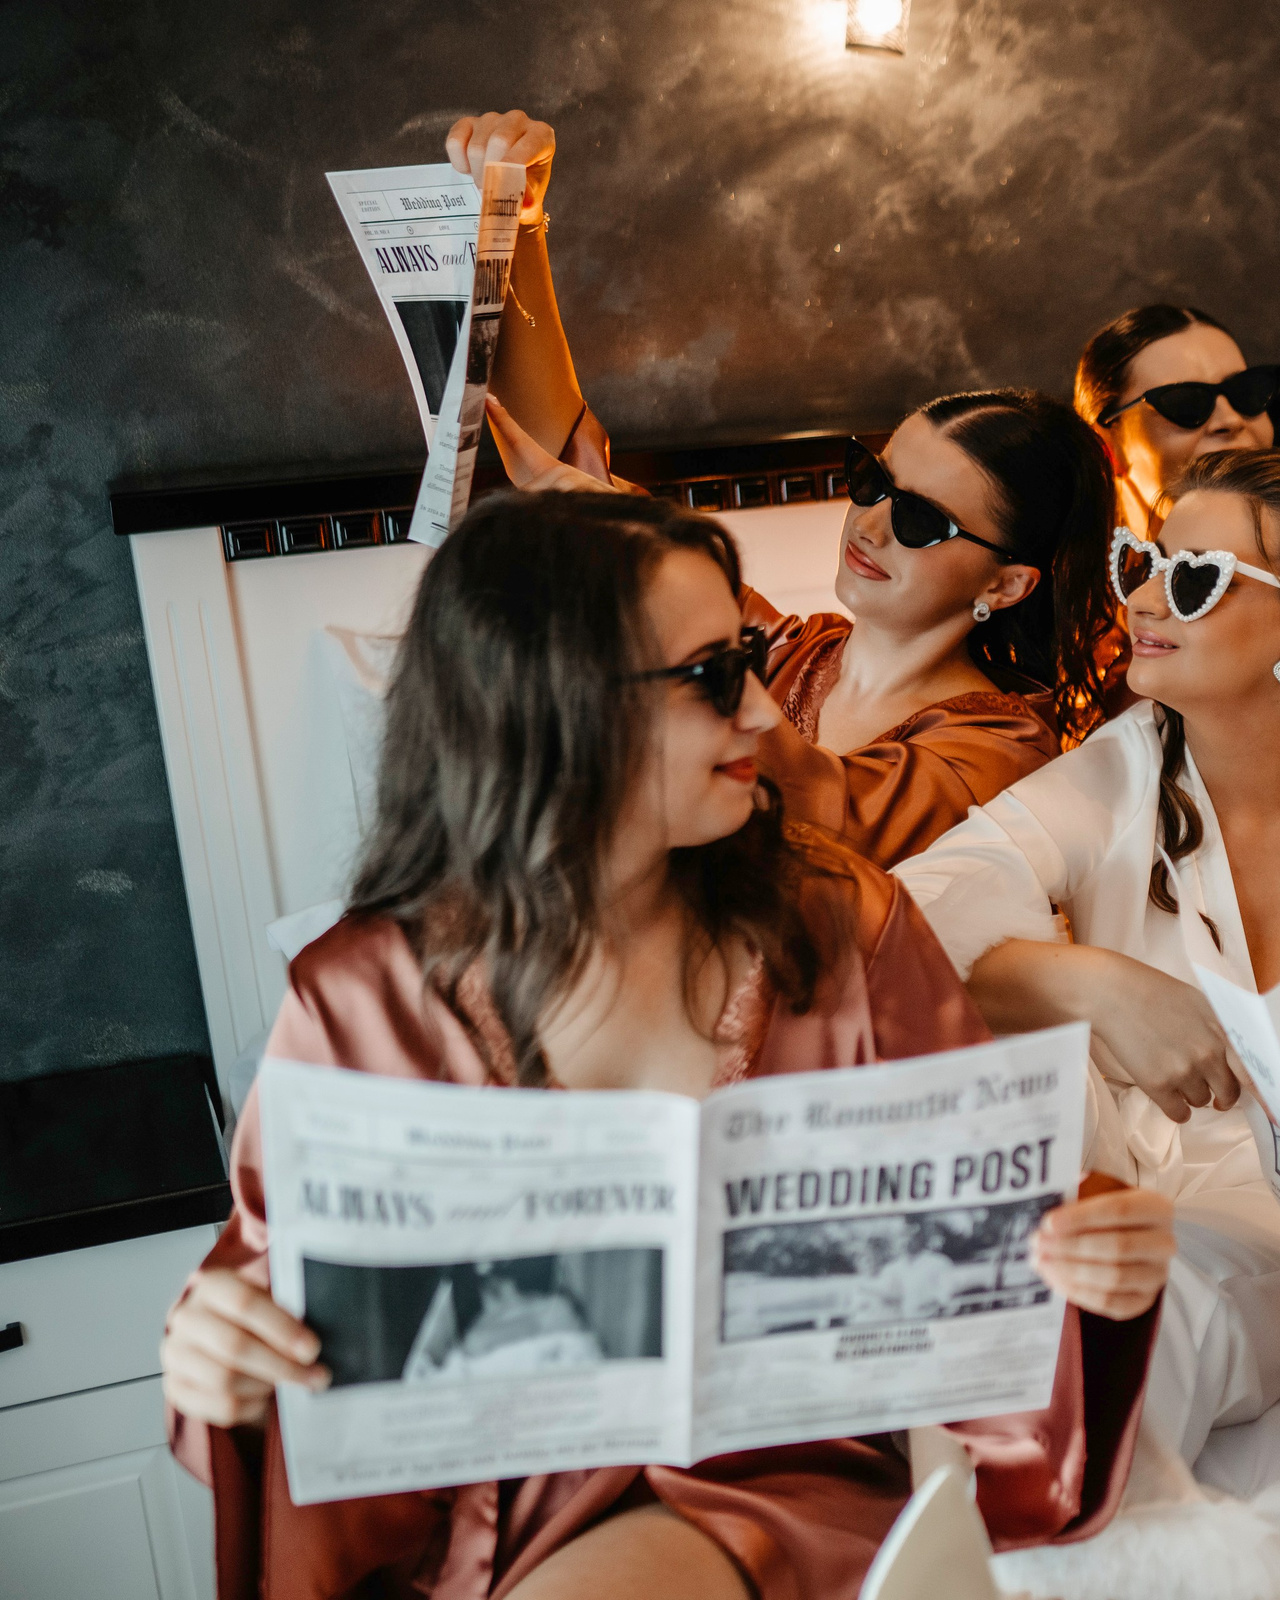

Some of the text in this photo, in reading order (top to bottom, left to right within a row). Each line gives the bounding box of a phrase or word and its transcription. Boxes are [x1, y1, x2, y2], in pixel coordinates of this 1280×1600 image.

[400, 194, 467, 211] Wedding Post
[375, 244, 439, 274] ALWAYS
[442, 241, 467, 265] and
[803, 1089, 964, 1131] Romantic
[975, 1069, 1061, 1112] News
[724, 1135, 1056, 1220] WEDDING POST
